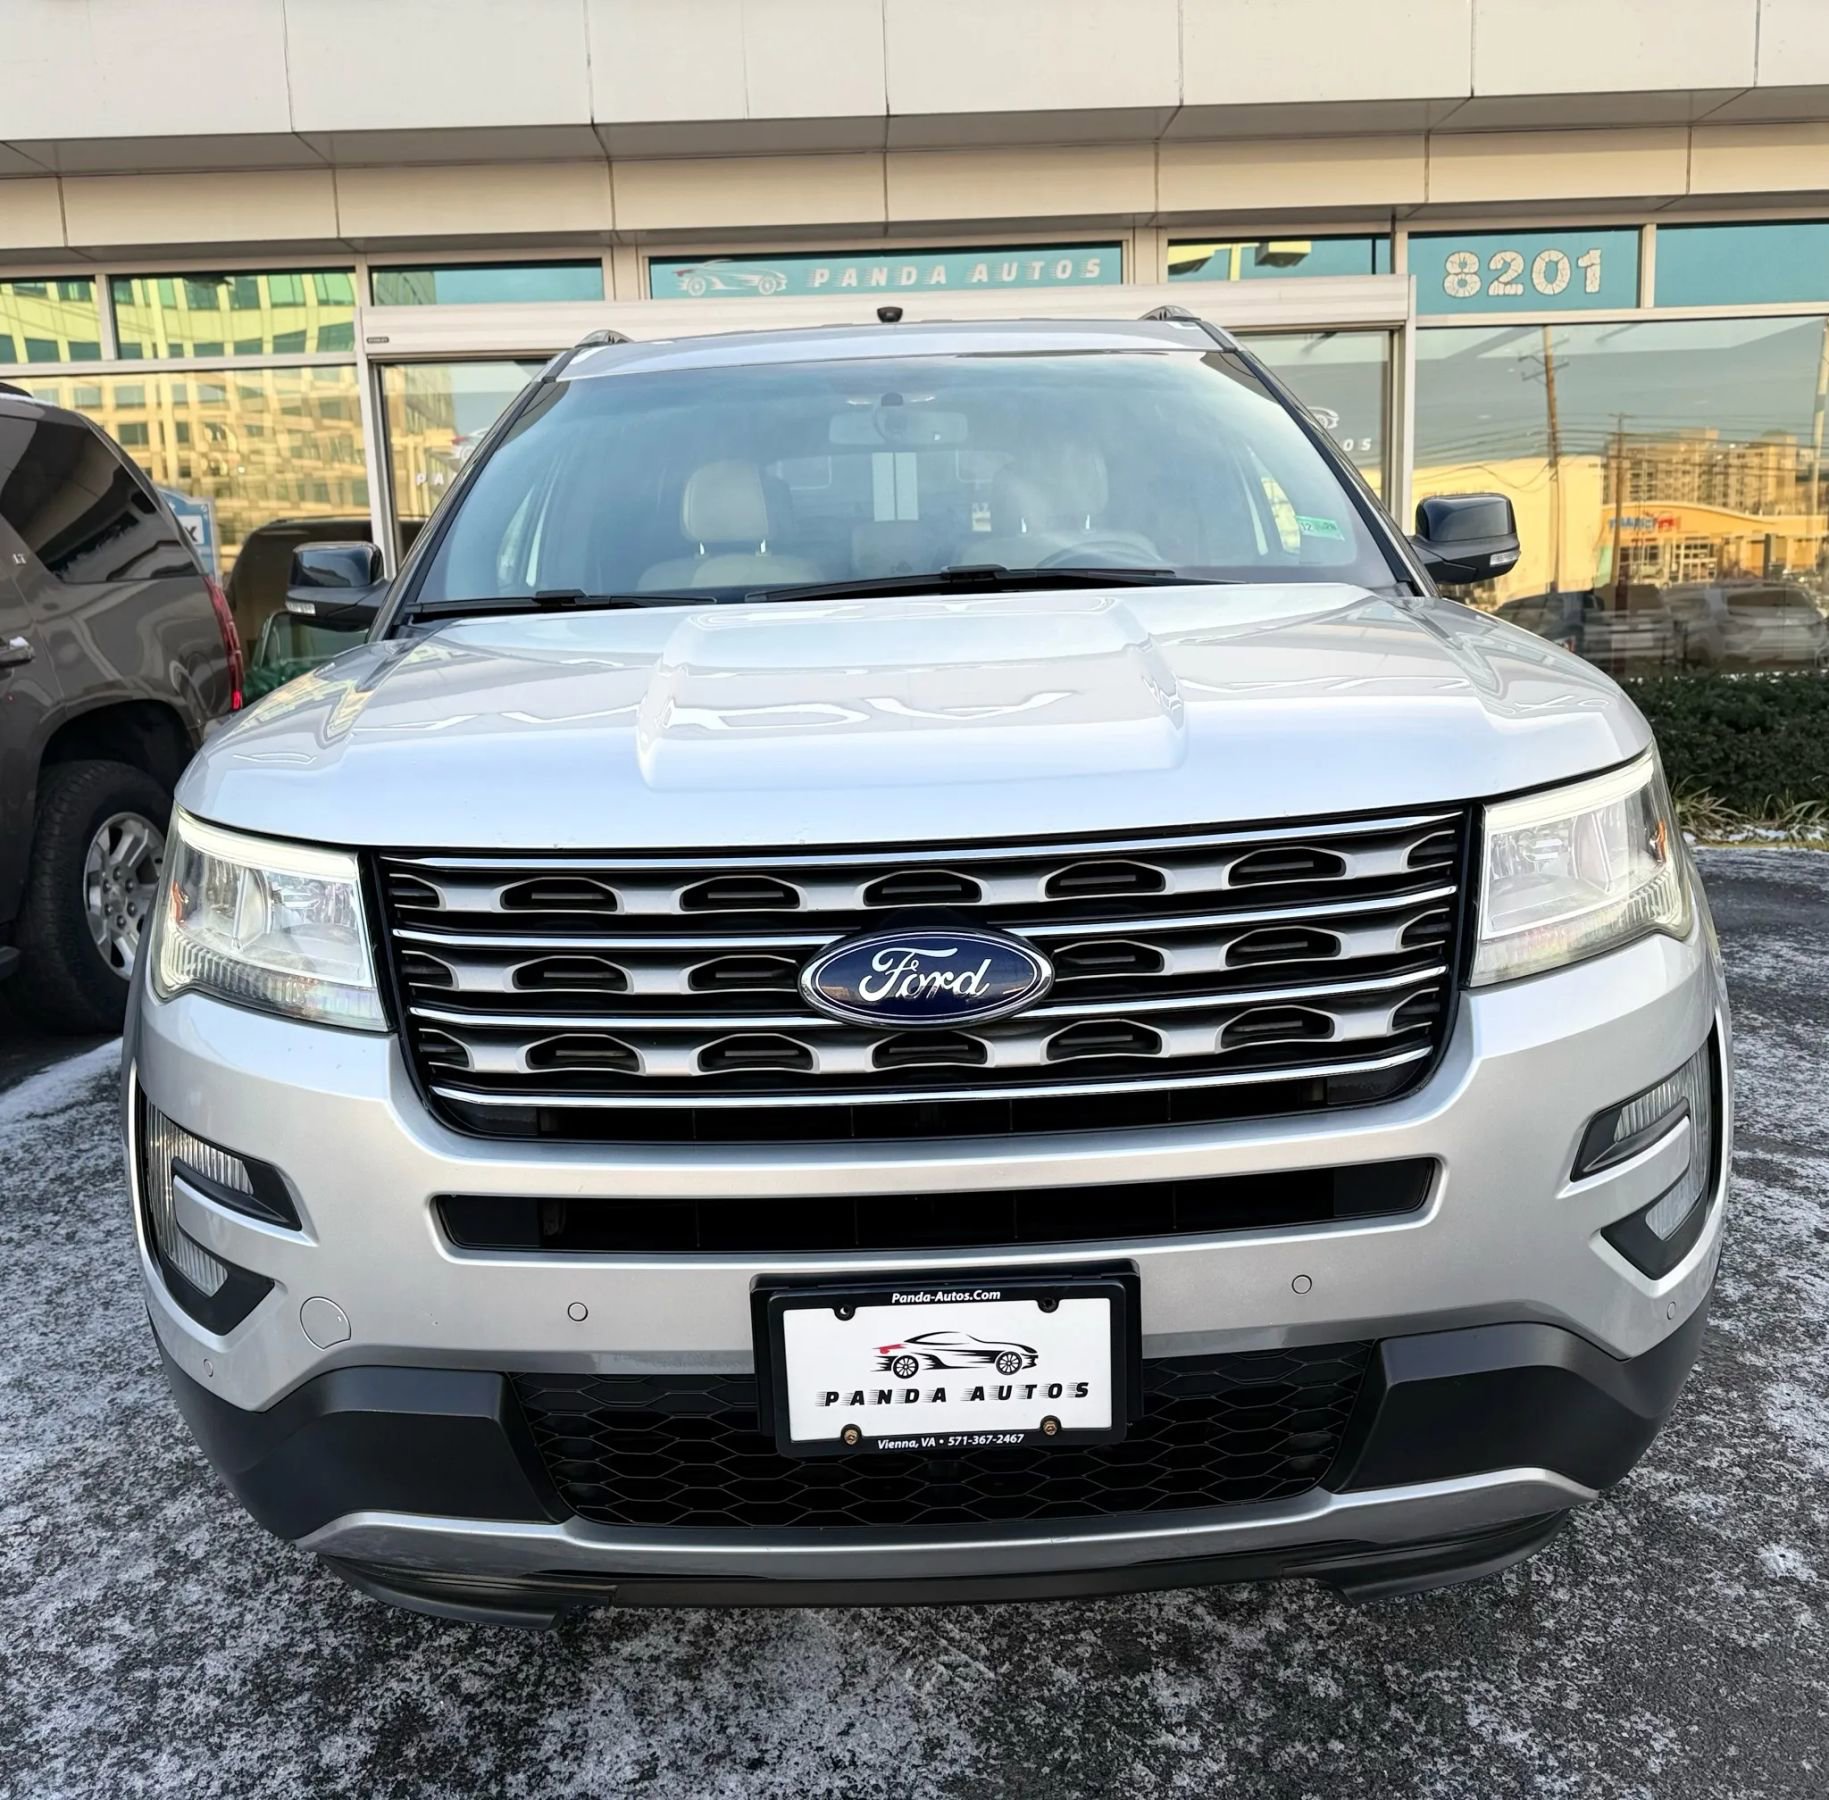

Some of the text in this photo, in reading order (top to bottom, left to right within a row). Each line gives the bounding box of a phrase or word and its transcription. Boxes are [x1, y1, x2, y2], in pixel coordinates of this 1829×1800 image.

[811, 258, 1101, 288] PANDA AUTOS
[1443, 248, 1602, 298] 8201
[858, 947, 992, 1001] Ford
[891, 1289, 1001, 1304] Panda-Autos.Com
[817, 1381, 1090, 1407] PANDA AUTOS
[877, 1433, 1025, 1450] Vienna, VA 571-367-2467
